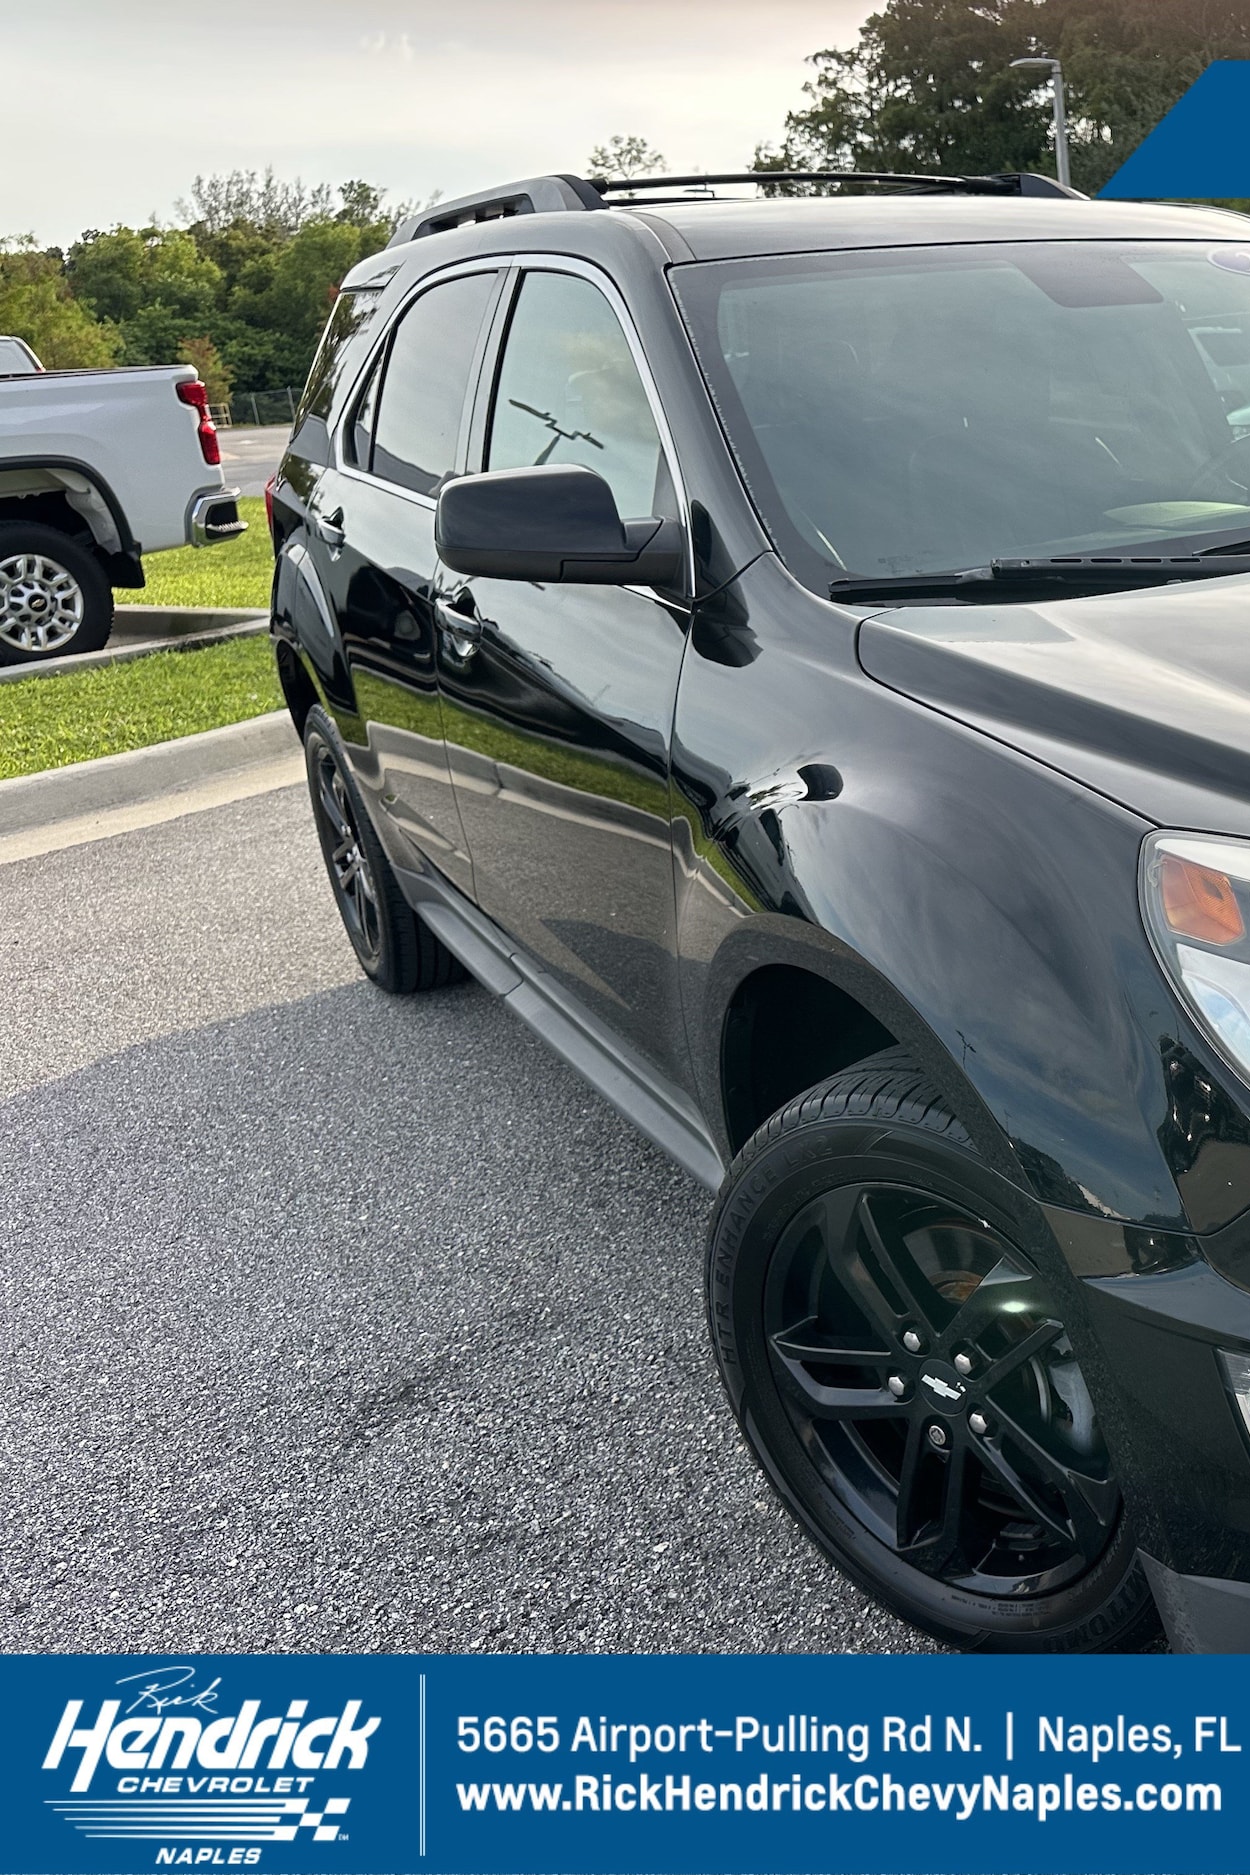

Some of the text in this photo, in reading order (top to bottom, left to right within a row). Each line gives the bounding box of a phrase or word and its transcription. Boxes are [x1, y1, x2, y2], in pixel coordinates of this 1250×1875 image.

[782, 1134, 834, 1166] LX2
[714, 1163, 778, 1287] ENHANCE
[714, 1302, 738, 1366] HTR
